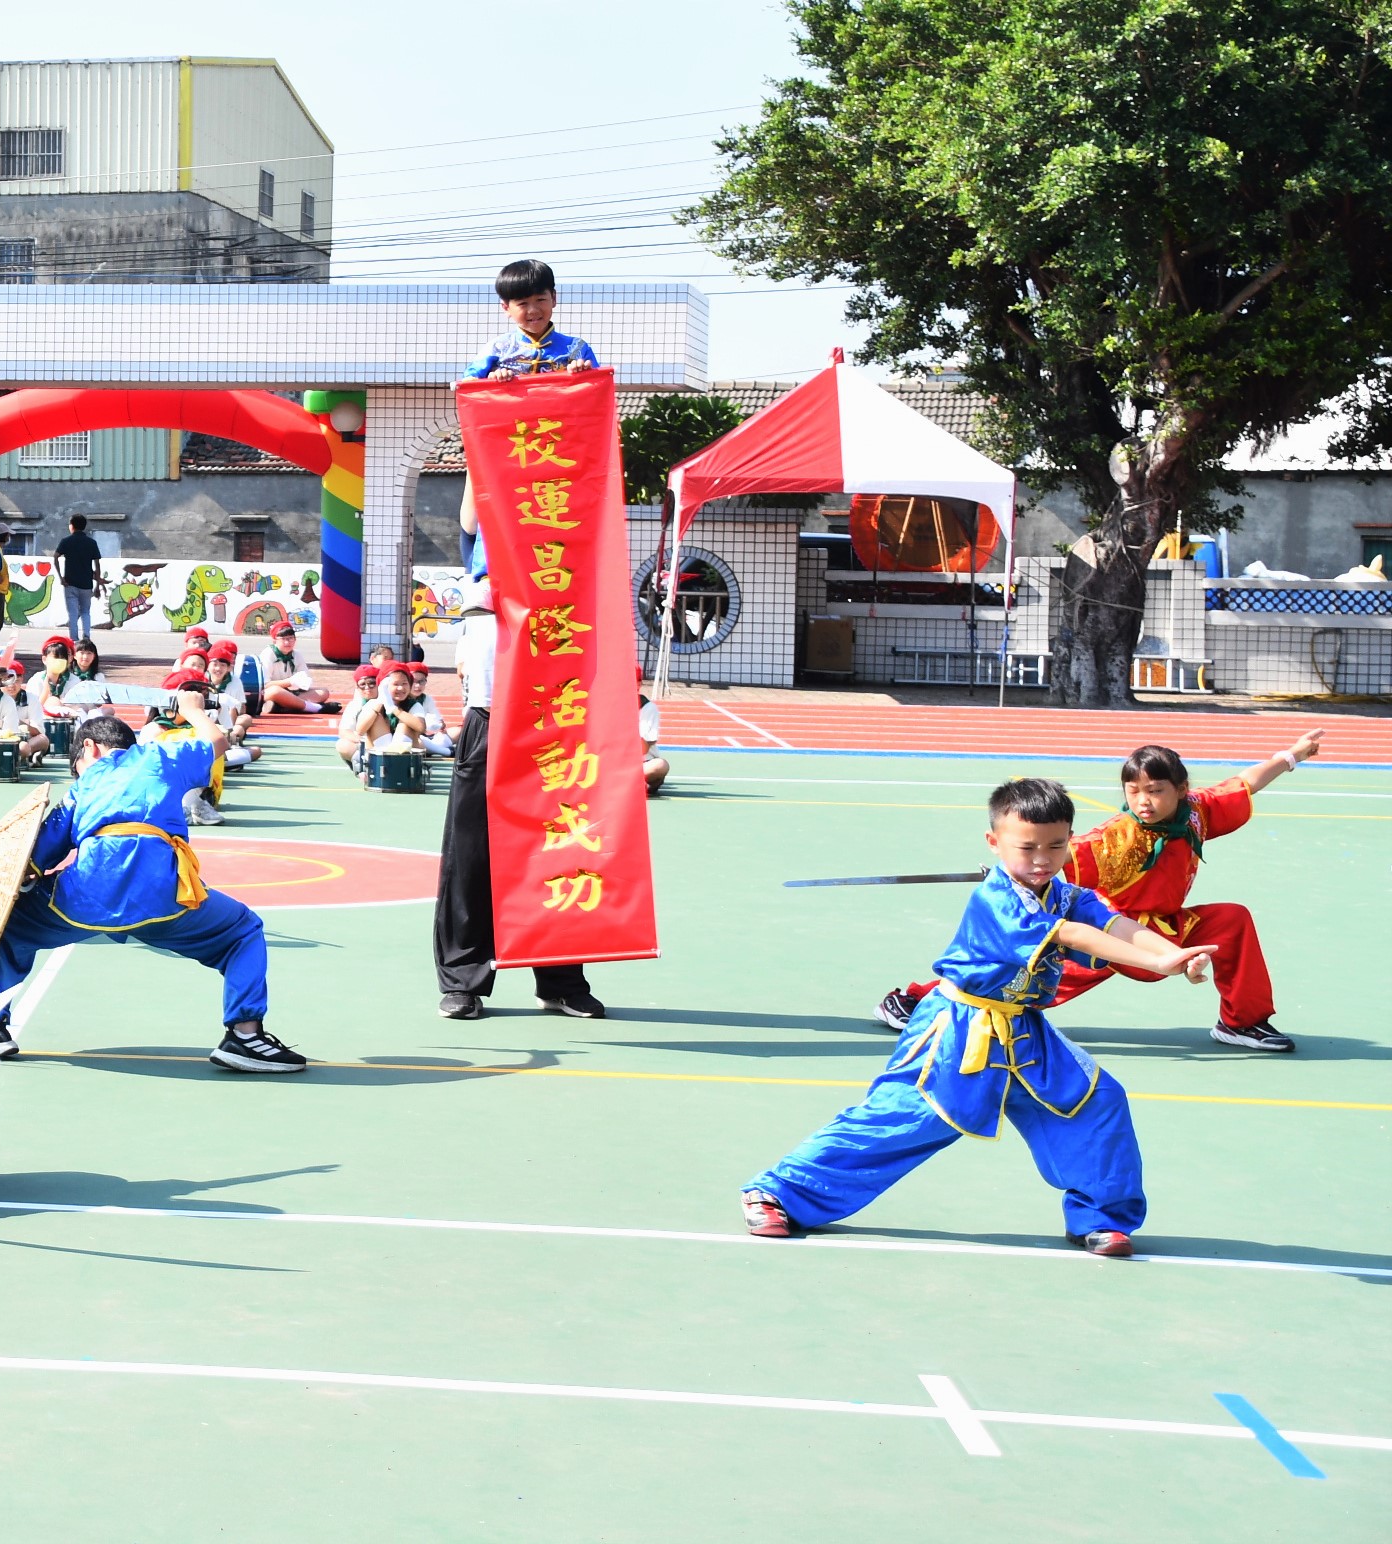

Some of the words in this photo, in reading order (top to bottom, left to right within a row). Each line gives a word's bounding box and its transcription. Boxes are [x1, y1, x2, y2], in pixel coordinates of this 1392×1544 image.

[507, 418, 604, 913] 校運昌隆活動成功
